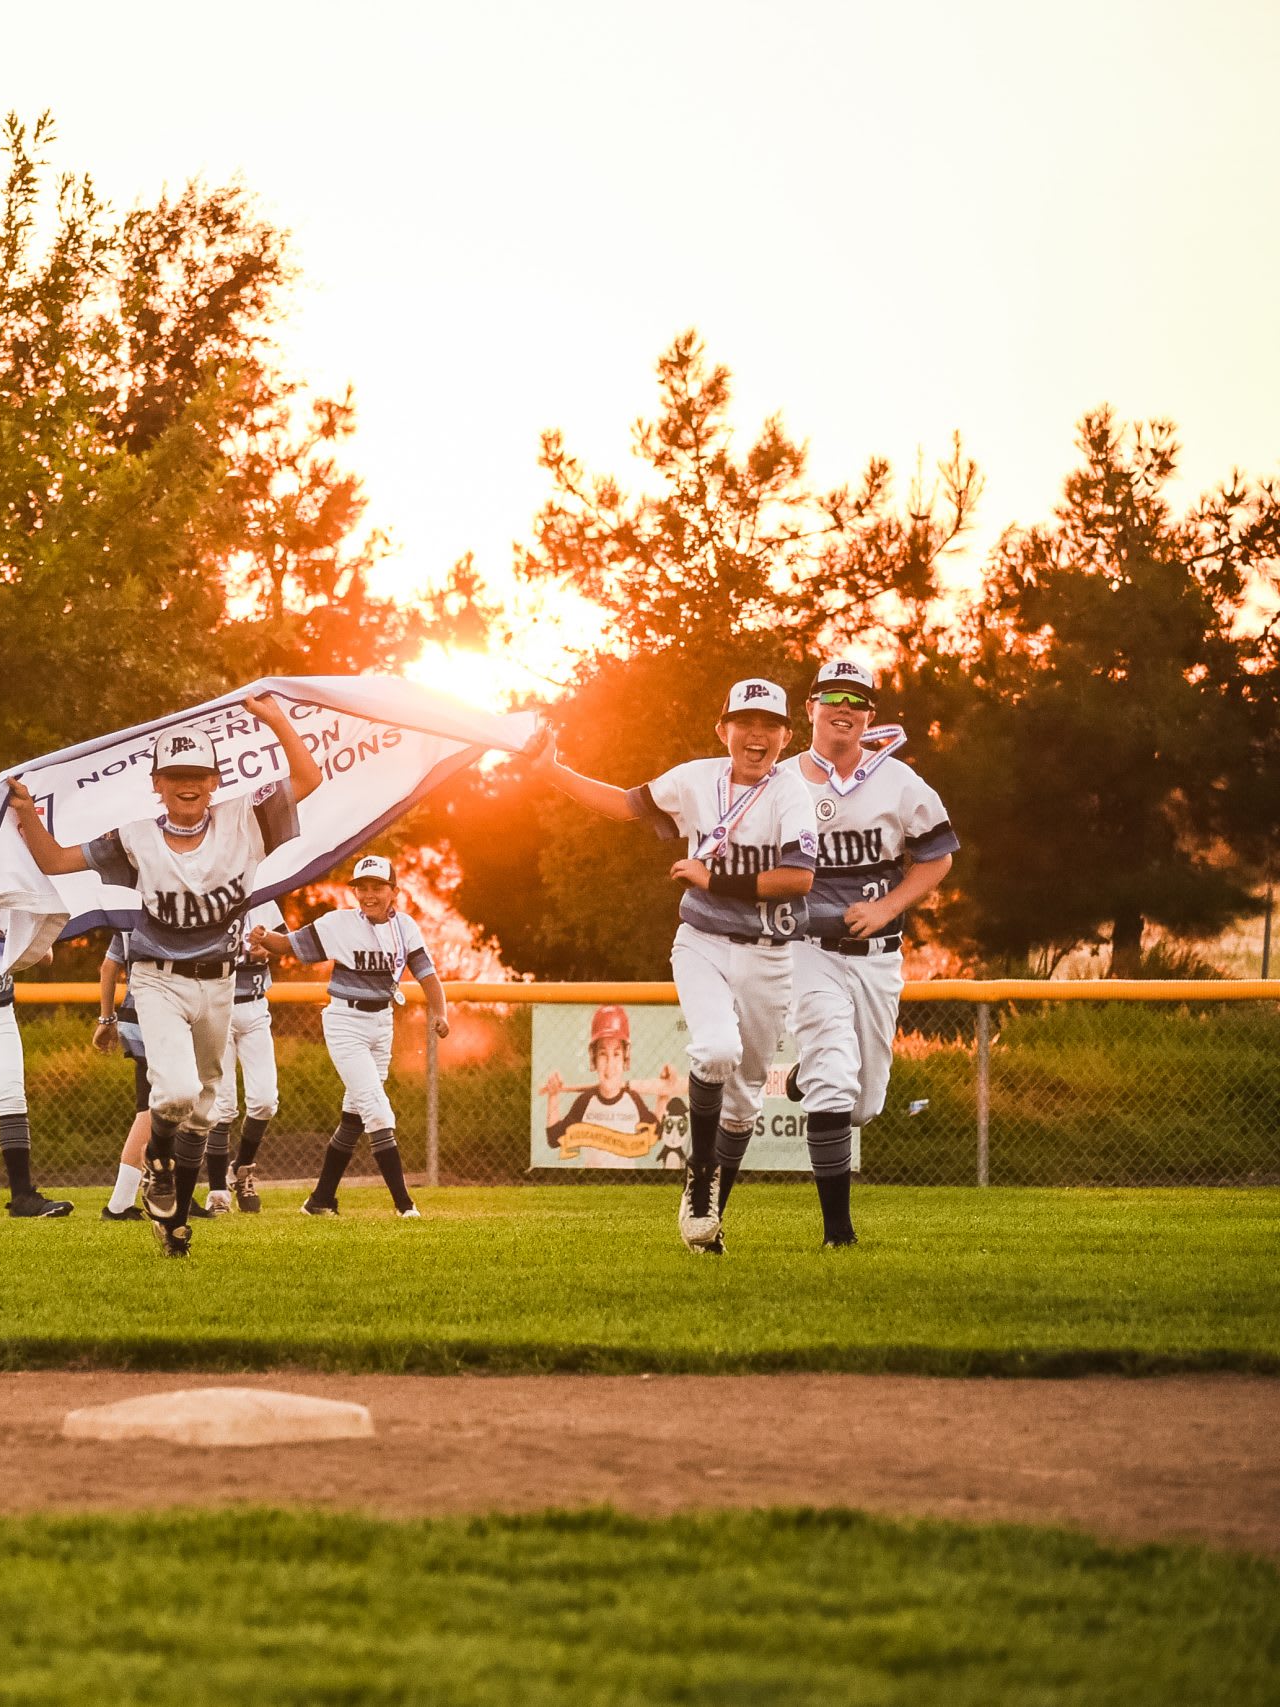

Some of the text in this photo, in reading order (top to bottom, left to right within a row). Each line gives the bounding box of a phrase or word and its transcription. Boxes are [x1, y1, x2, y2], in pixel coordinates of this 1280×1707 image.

[816, 827, 883, 867] AIDU
[155, 872, 247, 928] MAIDU
[755, 901, 798, 936] 16
[771, 1114, 808, 1137] car
